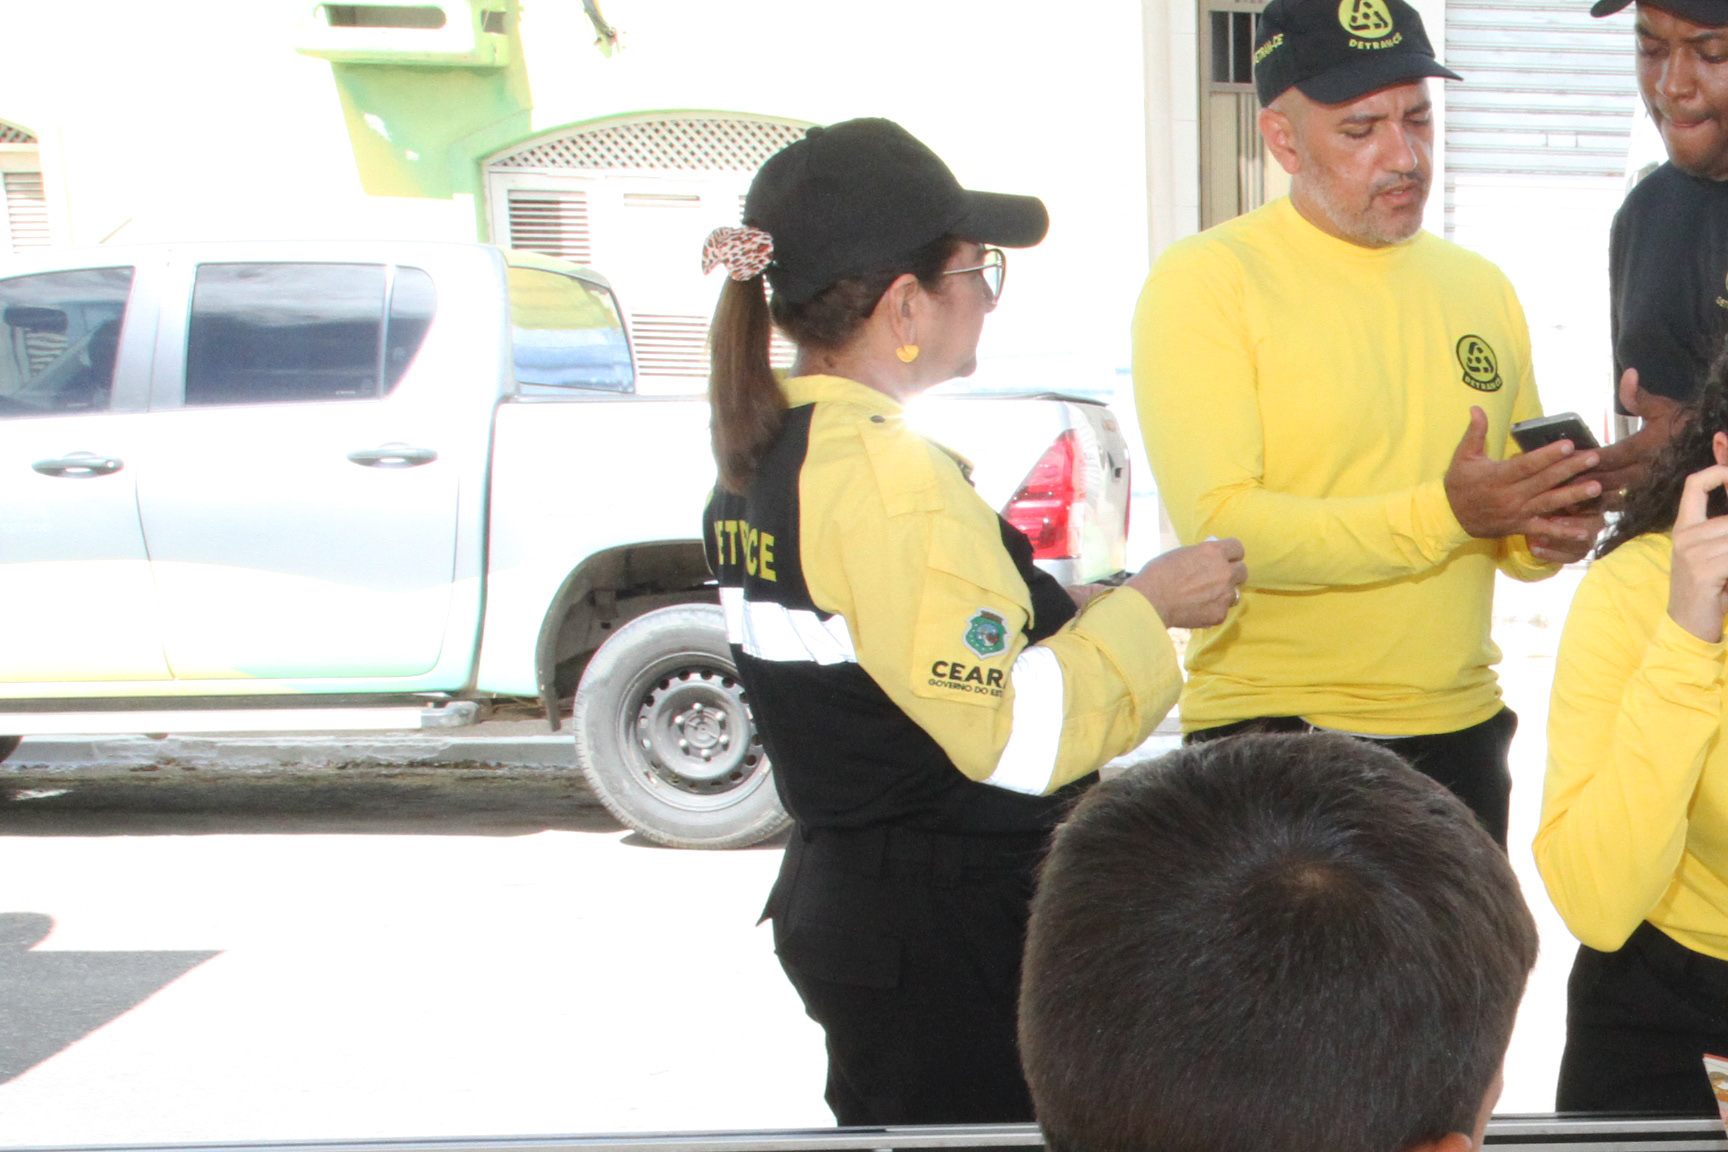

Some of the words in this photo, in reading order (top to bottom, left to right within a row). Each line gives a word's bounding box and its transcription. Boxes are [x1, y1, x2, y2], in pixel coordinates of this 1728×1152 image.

[931, 660, 1007, 689] CEAR
[928, 678, 973, 693] GOVERNO
[974, 685, 989, 695] DO
